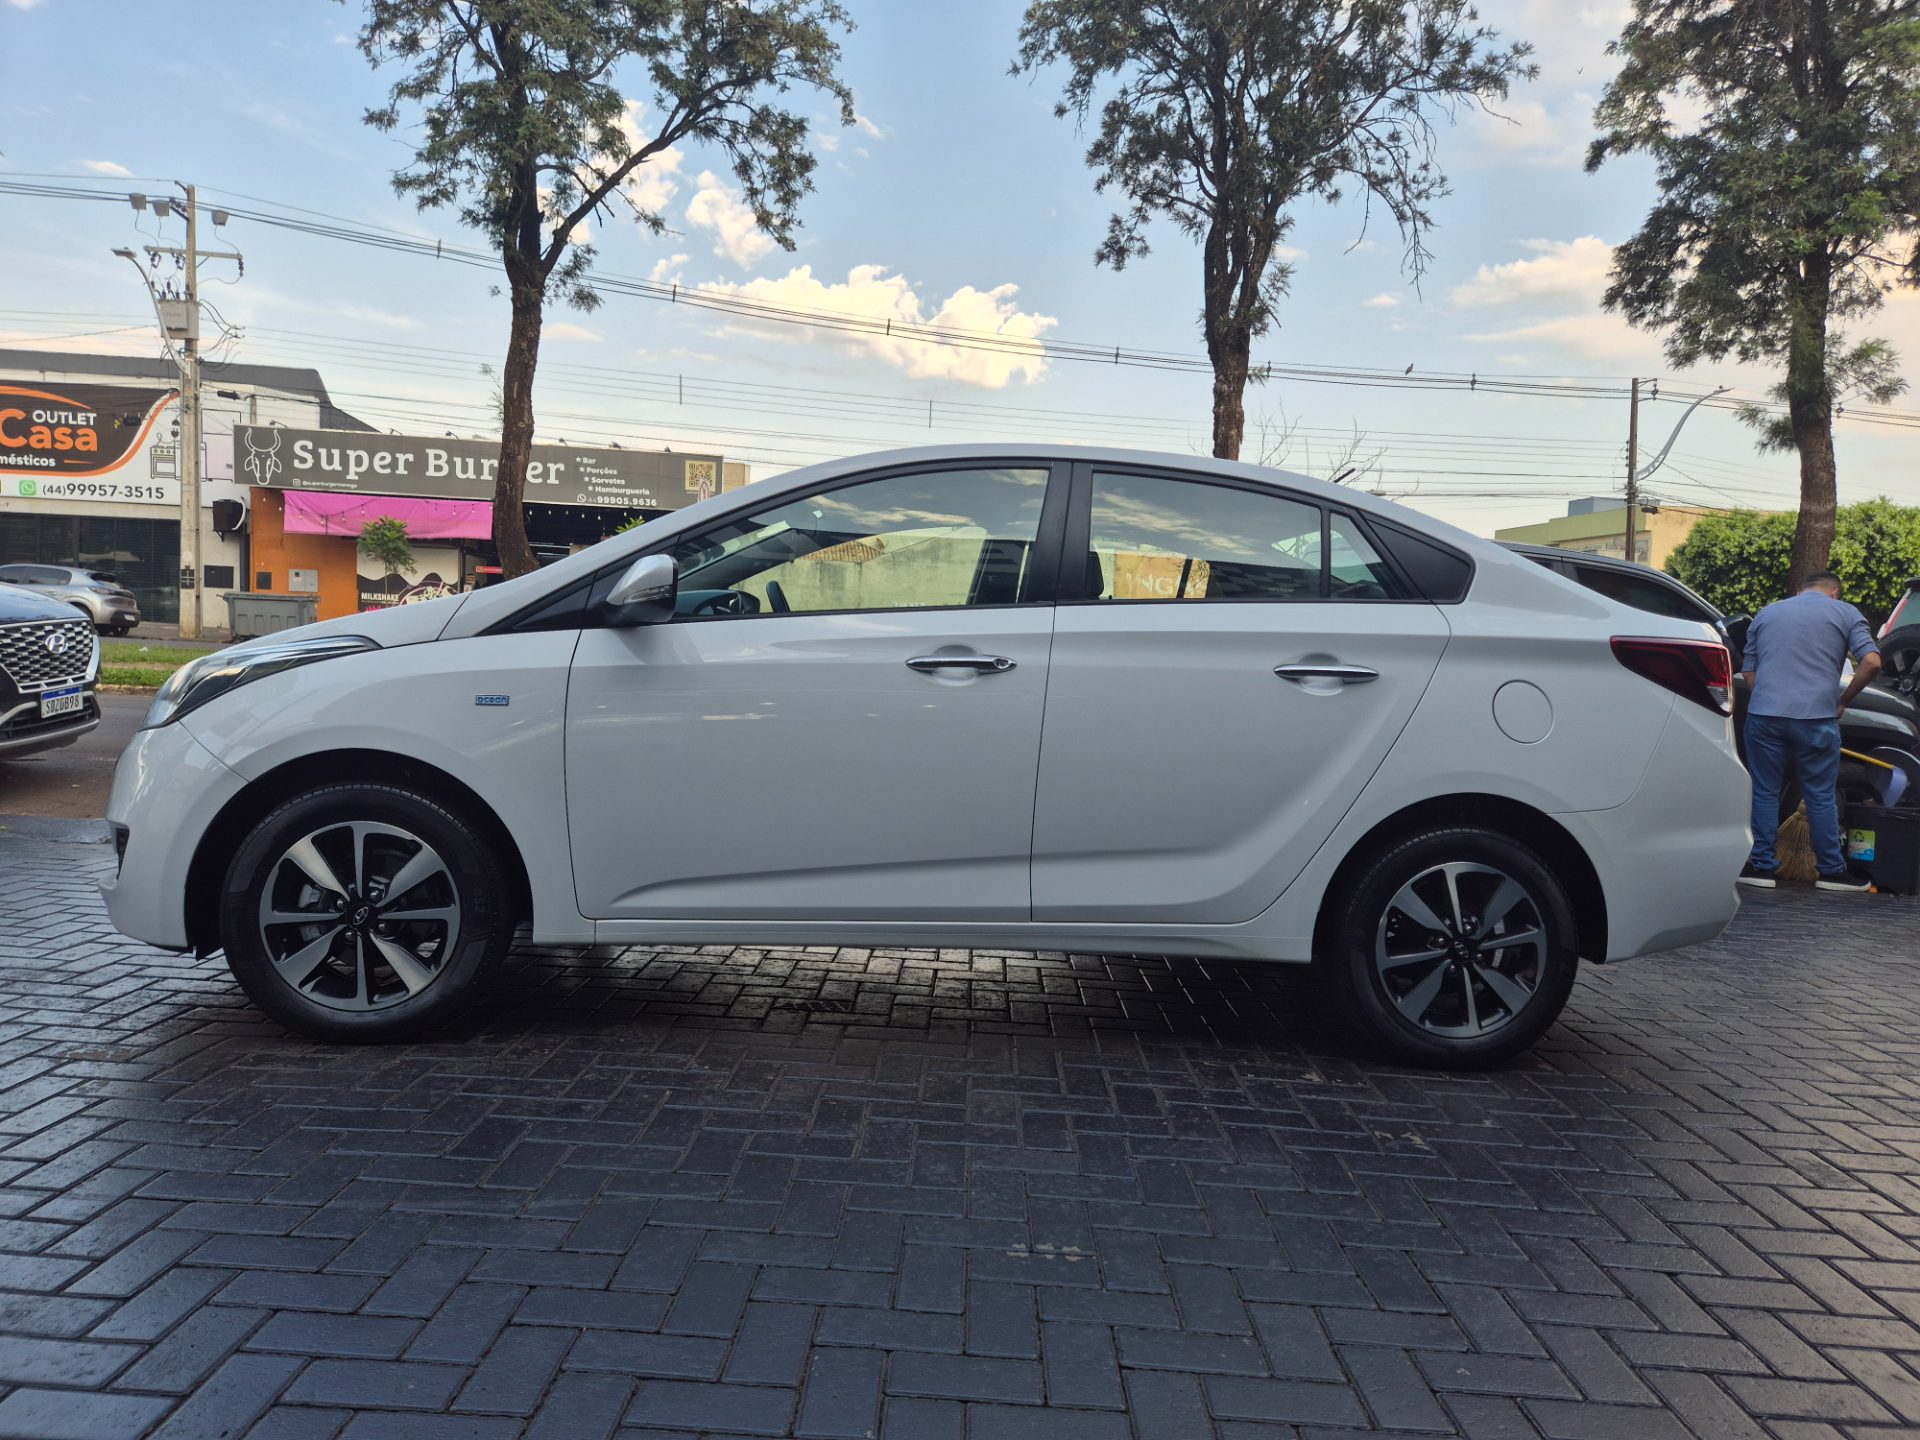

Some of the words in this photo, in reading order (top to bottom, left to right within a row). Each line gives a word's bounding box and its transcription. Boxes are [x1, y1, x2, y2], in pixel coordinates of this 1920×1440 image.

[32, 409, 97, 426] OUTLET
[0, 408, 98, 451] Casa
[0, 453, 56, 467] mésticos
[293, 440, 414, 480] Super
[425, 448, 565, 485] Burer
[586, 467, 617, 475] Porções
[591, 476, 625, 485] Sorvetes
[42, 483, 165, 499] (44)99957-3515
[595, 486, 650, 495] Hamburgueria
[361, 592, 400, 602] MILKSHAKE
